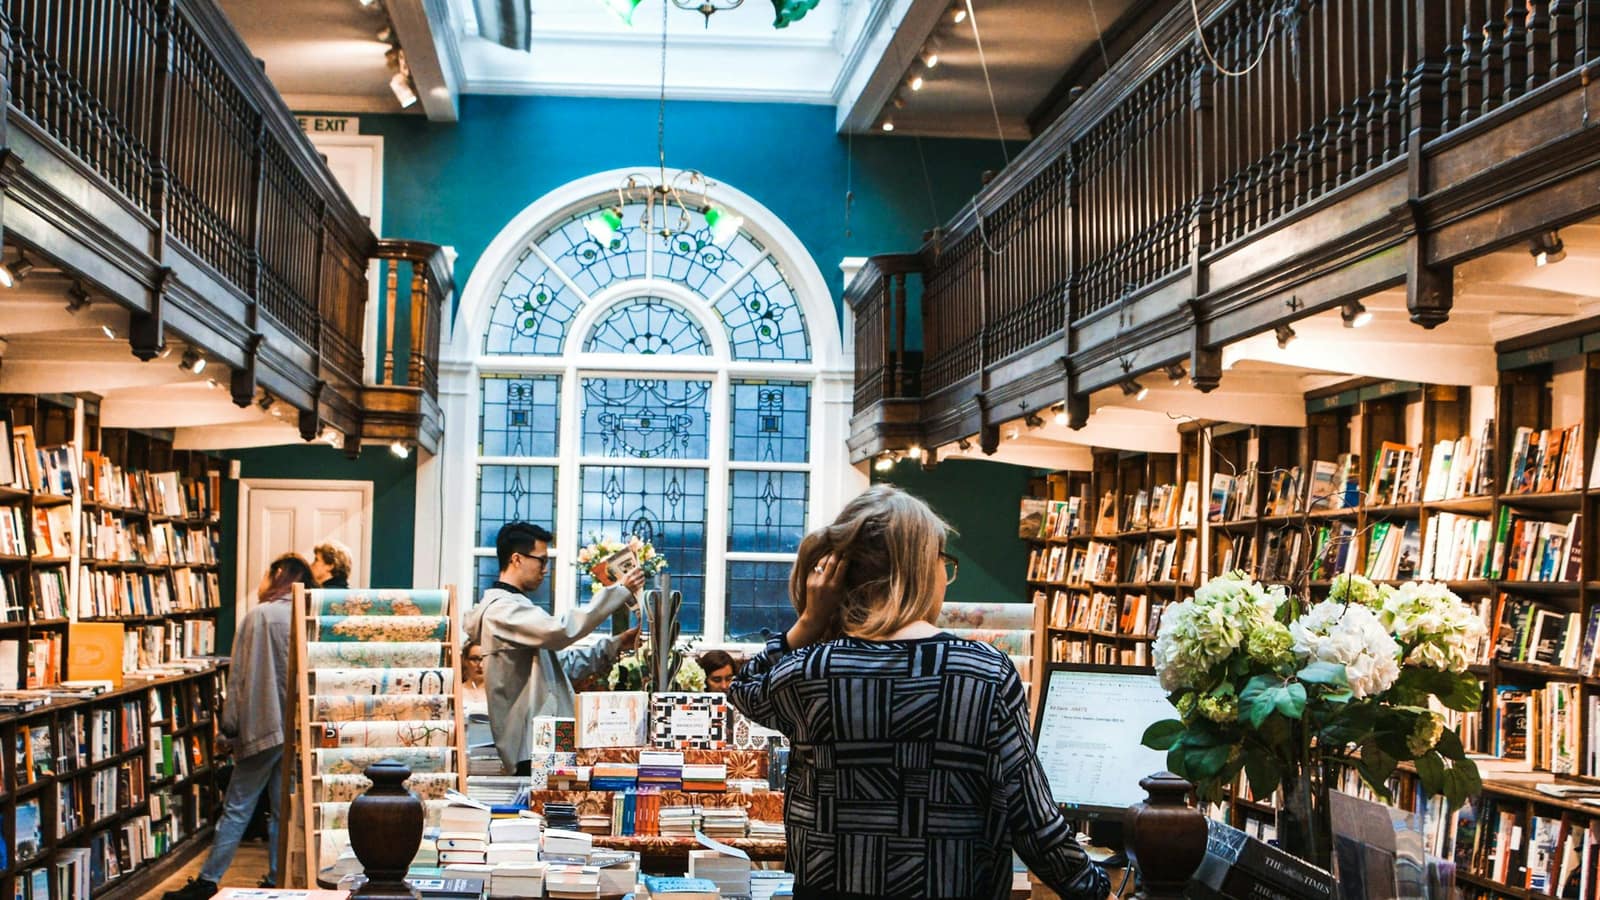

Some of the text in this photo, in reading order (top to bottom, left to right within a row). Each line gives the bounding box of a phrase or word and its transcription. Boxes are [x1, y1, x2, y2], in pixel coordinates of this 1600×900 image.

[314, 118, 348, 131] EXIT
[1265, 857, 1331, 895] THE TIMES
